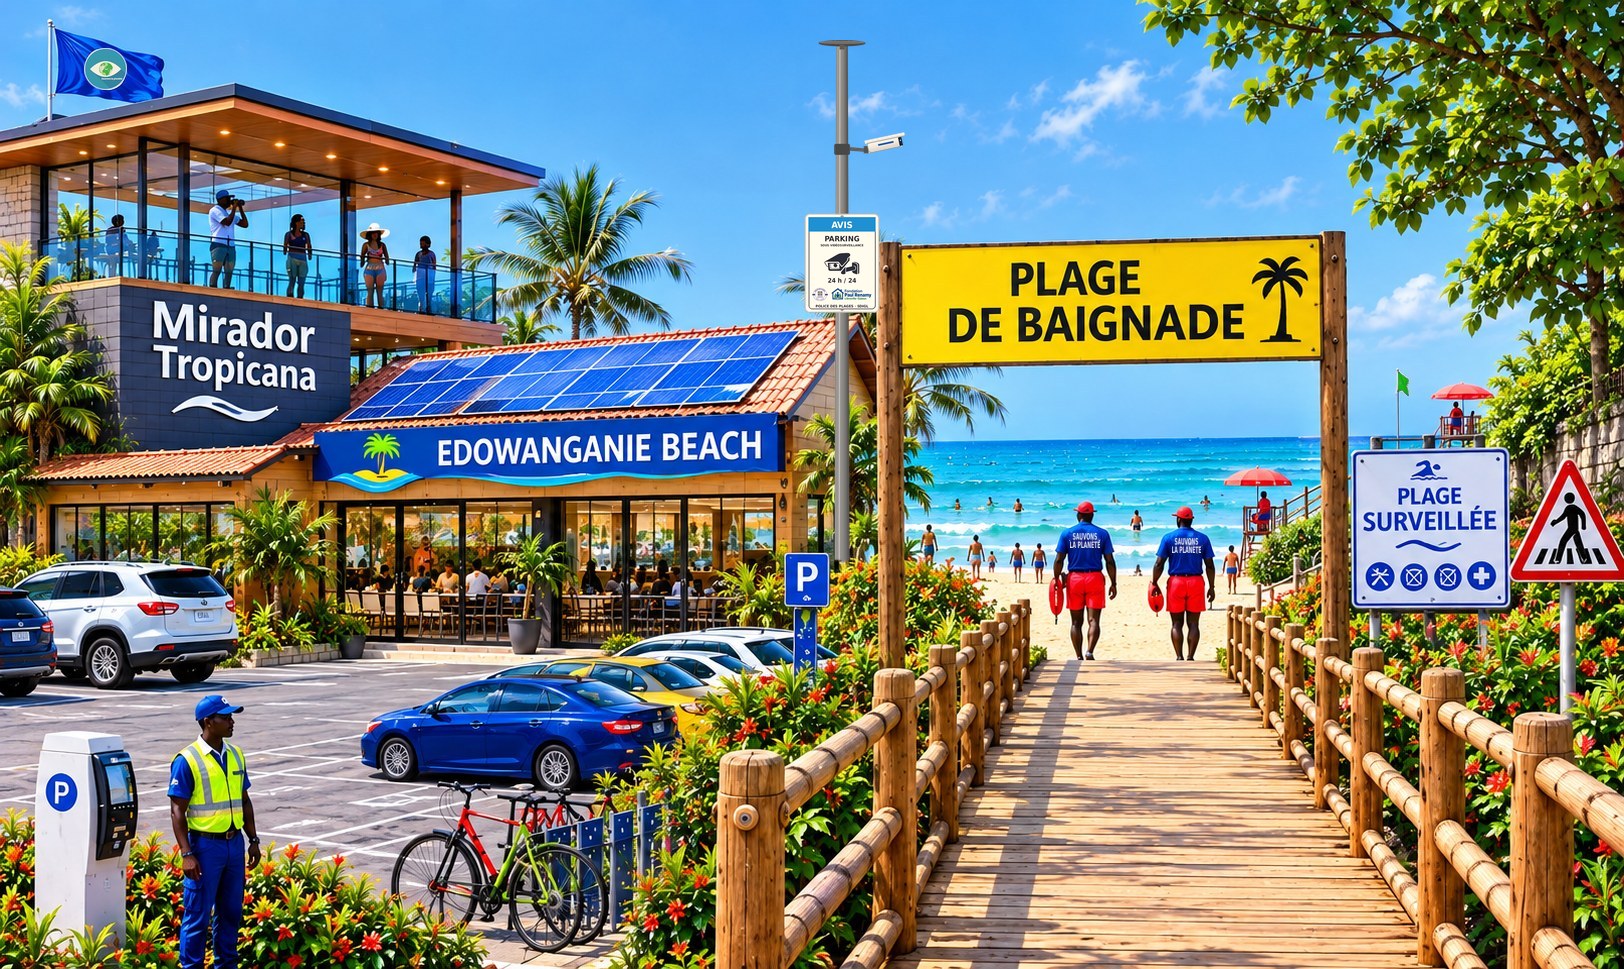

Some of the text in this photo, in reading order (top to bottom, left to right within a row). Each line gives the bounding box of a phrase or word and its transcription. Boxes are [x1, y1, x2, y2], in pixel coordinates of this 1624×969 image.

[831, 221, 853, 229] AVIS
[1010, 259, 1141, 297] PLAGE
[153, 300, 316, 354] Mirador
[949, 303, 1245, 343] DE BAIGNADE
[153, 344, 317, 391] Tropicana
[437, 429, 762, 466] EDOWANGANIE BEACH
[1398, 487, 1462, 505] PLAGE
[1363, 505, 1497, 532] SURVEILLÉE
[1069, 541, 1077, 549] LA
[1072, 532, 1098, 540] SAUVONS
[1174, 537, 1199, 545] SAUVONS
[1171, 546, 1178, 554] LA
[797, 561, 819, 592] P
[54, 780, 70, 805] P
